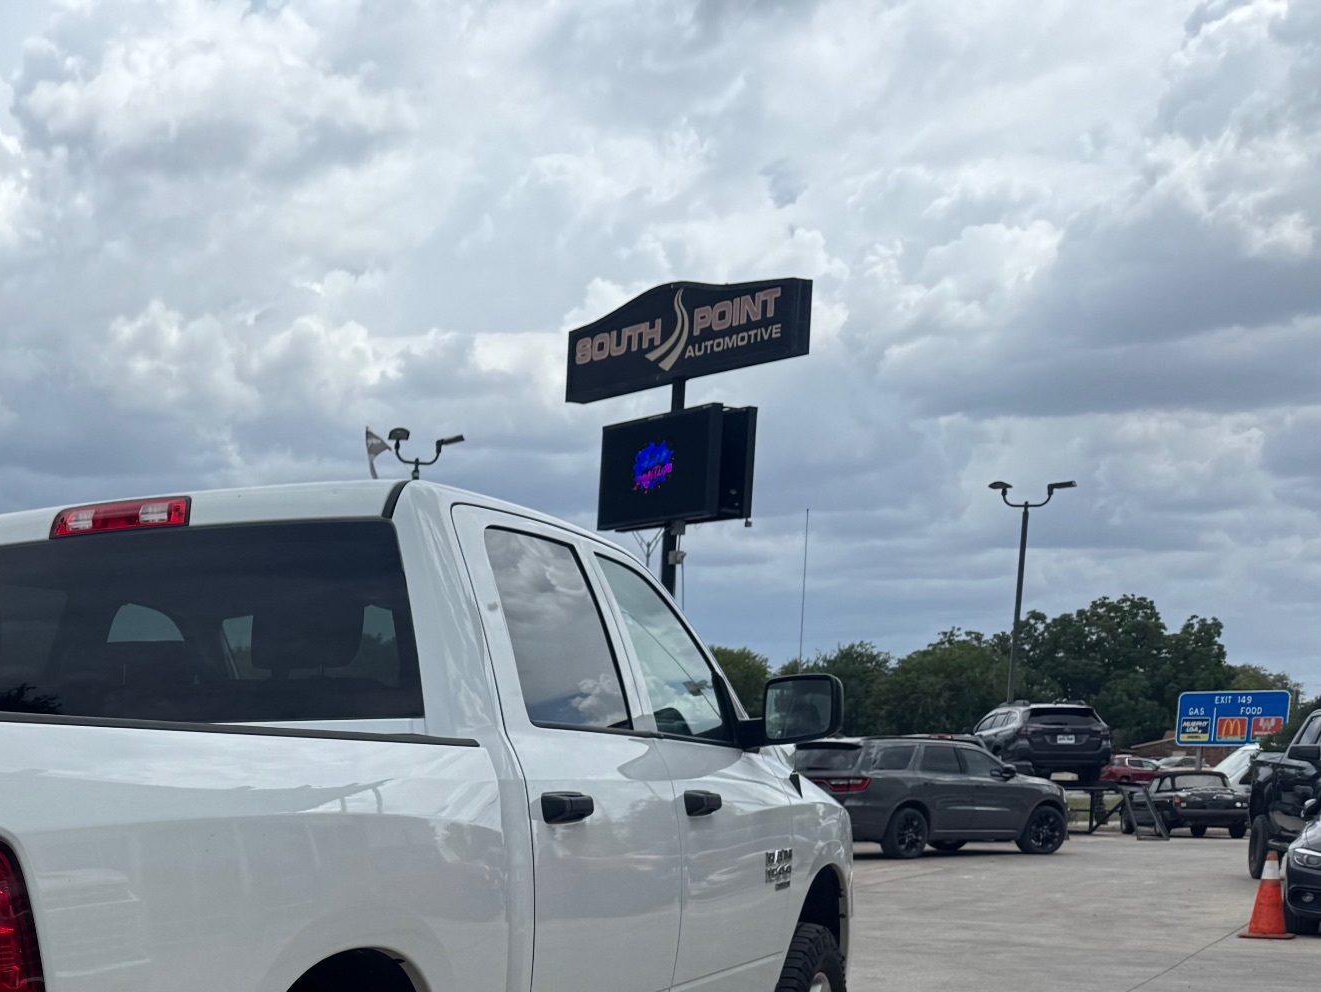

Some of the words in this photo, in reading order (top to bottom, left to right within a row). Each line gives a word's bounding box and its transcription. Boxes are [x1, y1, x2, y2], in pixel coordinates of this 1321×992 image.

[575, 318, 662, 365] SOUTH
[692, 286, 782, 337] POINT
[684, 323, 782, 360] AUTOMOTIVE
[1214, 695, 1233, 704] EXIT
[1237, 695, 1253, 704] 149
[1188, 707, 1205, 715] GAS
[1239, 706, 1263, 715] FOOD
